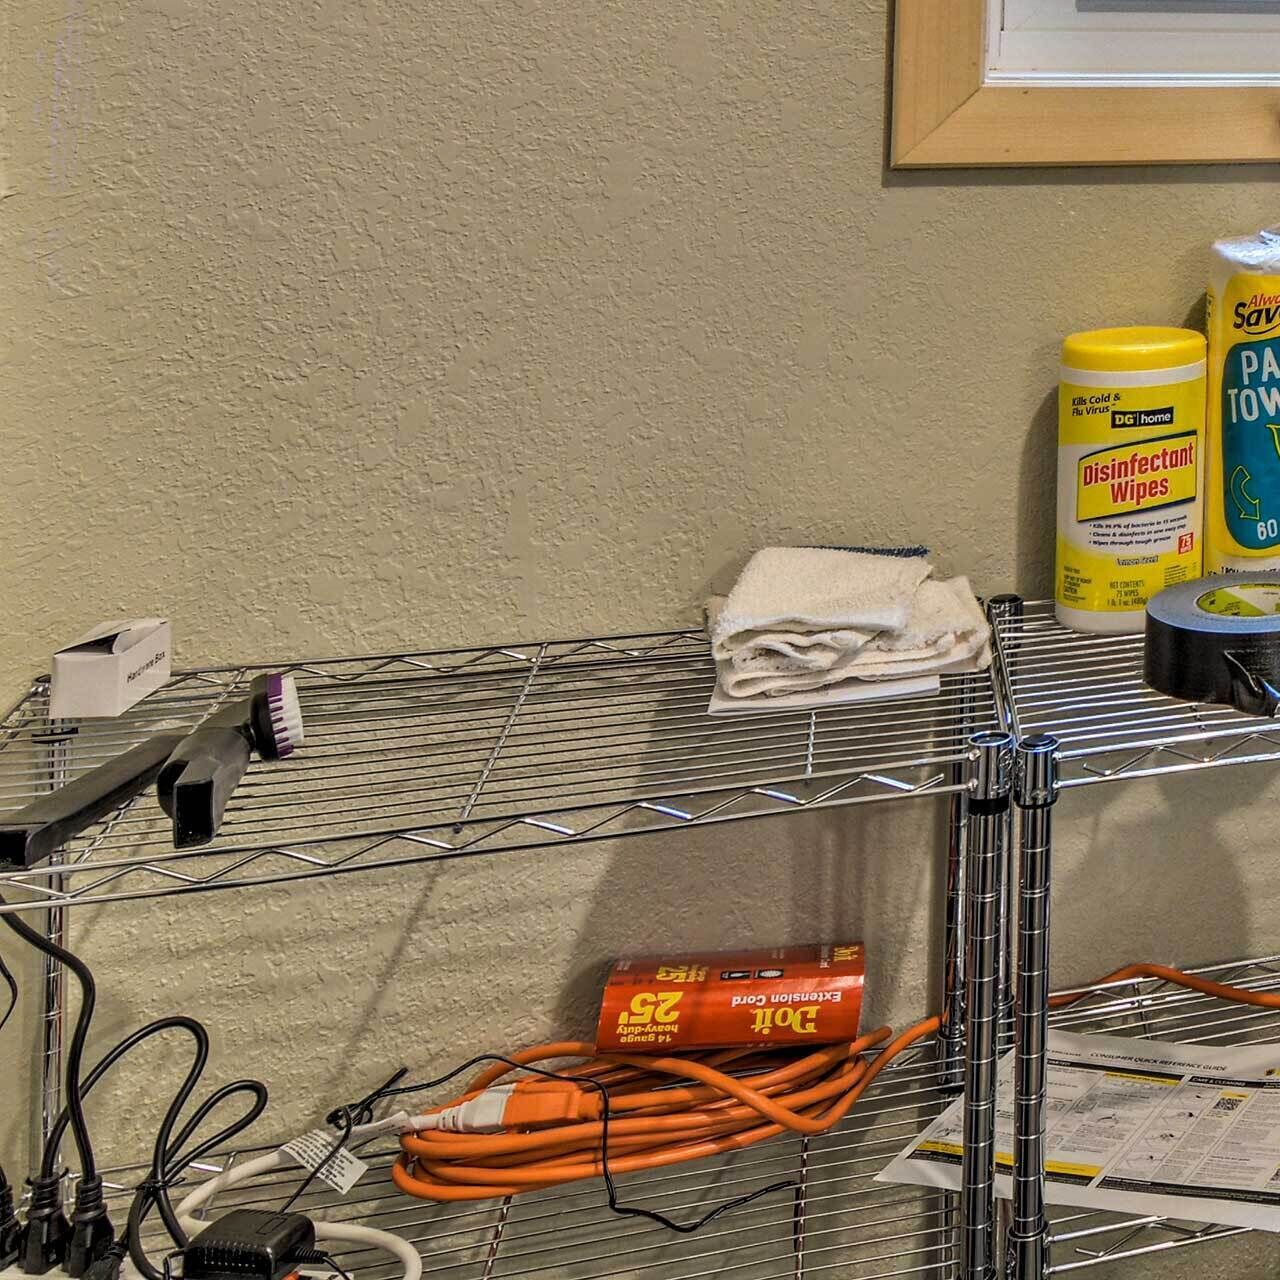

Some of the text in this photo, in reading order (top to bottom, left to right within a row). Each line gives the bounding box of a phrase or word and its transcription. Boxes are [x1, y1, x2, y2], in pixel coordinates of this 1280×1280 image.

[1072, 393, 1120, 407] Kills Cold &
[1072, 406, 1109, 416] Flu Virus
[1114, 412, 1171, 425] DG home
[1084, 442, 1194, 487] Disinfectant
[1110, 477, 1169, 506] Wipes
[1256, 520, 1278, 541] 60
[155, 651, 165, 664] Box
[732, 991, 842, 1008] Extension Cord
[618, 991, 684, 1025] 25'
[616, 1024, 679, 1035] heavy-duty
[620, 1034, 672, 1044] 14 gauge
